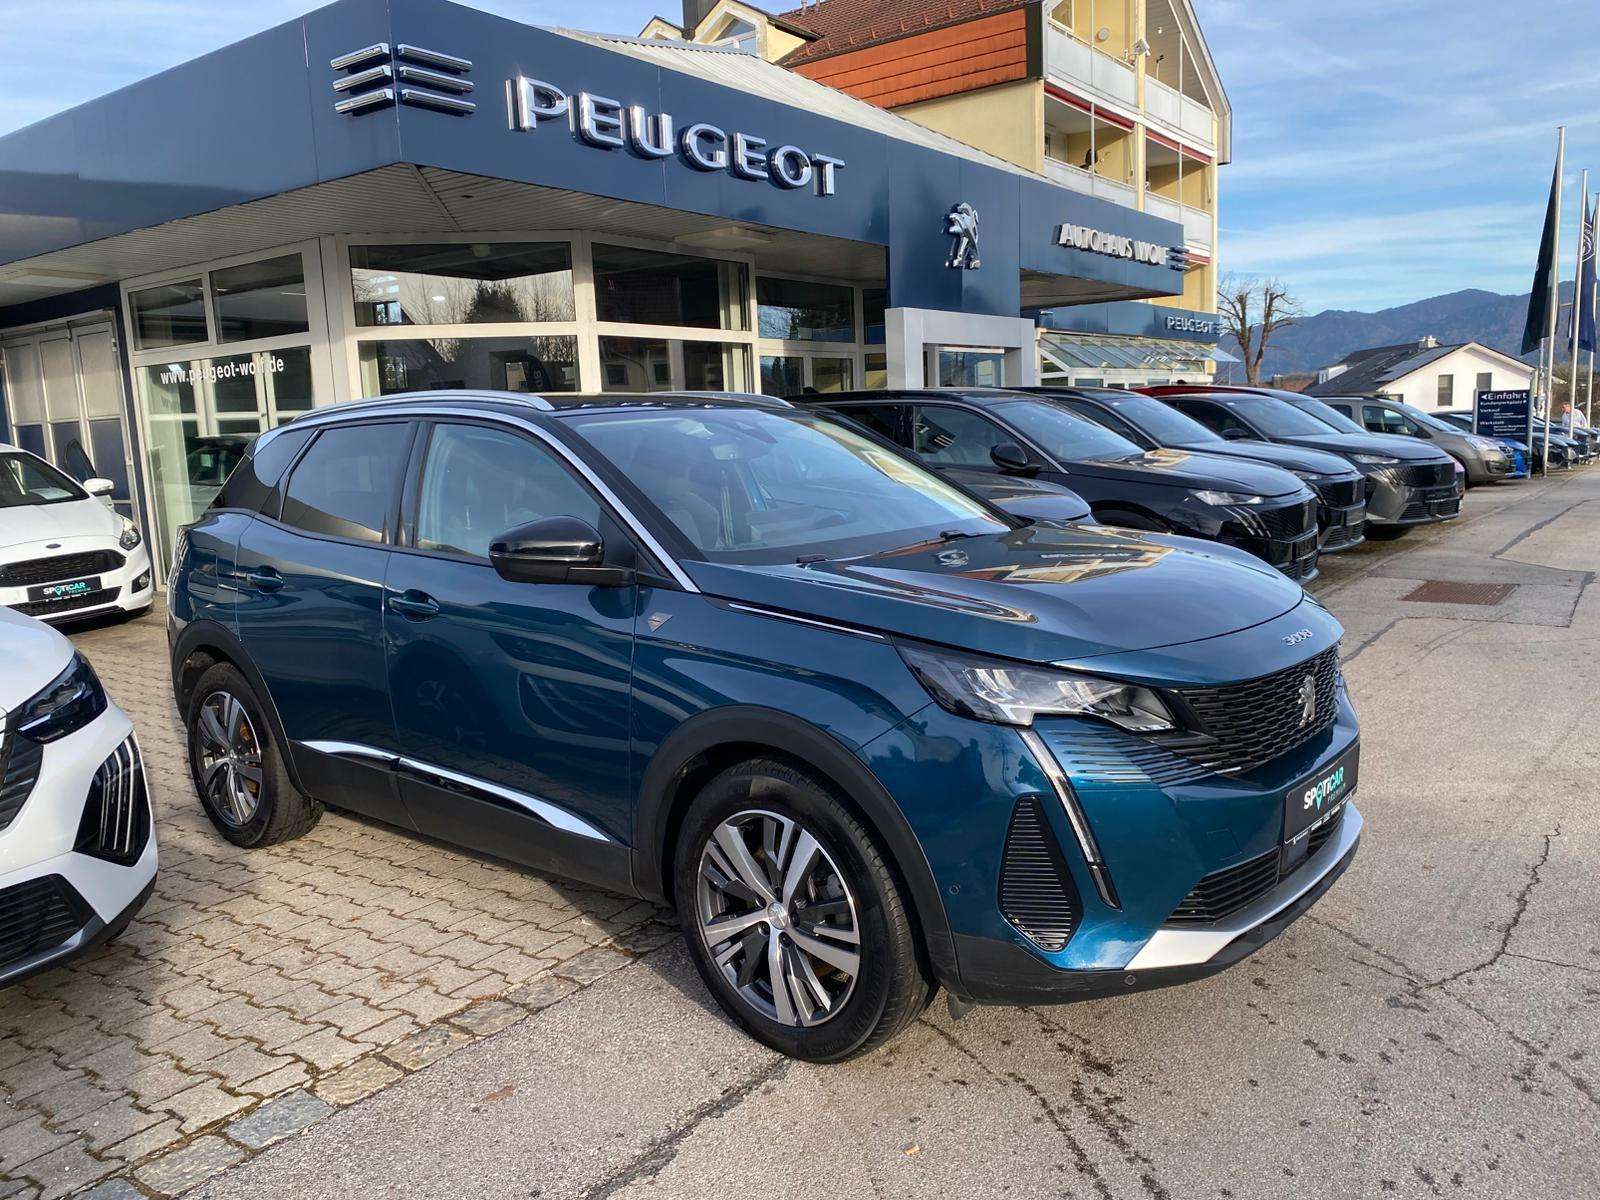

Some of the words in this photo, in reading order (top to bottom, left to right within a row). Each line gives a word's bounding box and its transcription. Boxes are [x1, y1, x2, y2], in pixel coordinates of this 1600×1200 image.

[506, 74, 846, 197] PEUGEOT
[1059, 223, 1133, 258] AUTOHAUS
[1167, 316, 1214, 334] PEUGEOT
[160, 356, 284, 385] www.peugeot-wolfde
